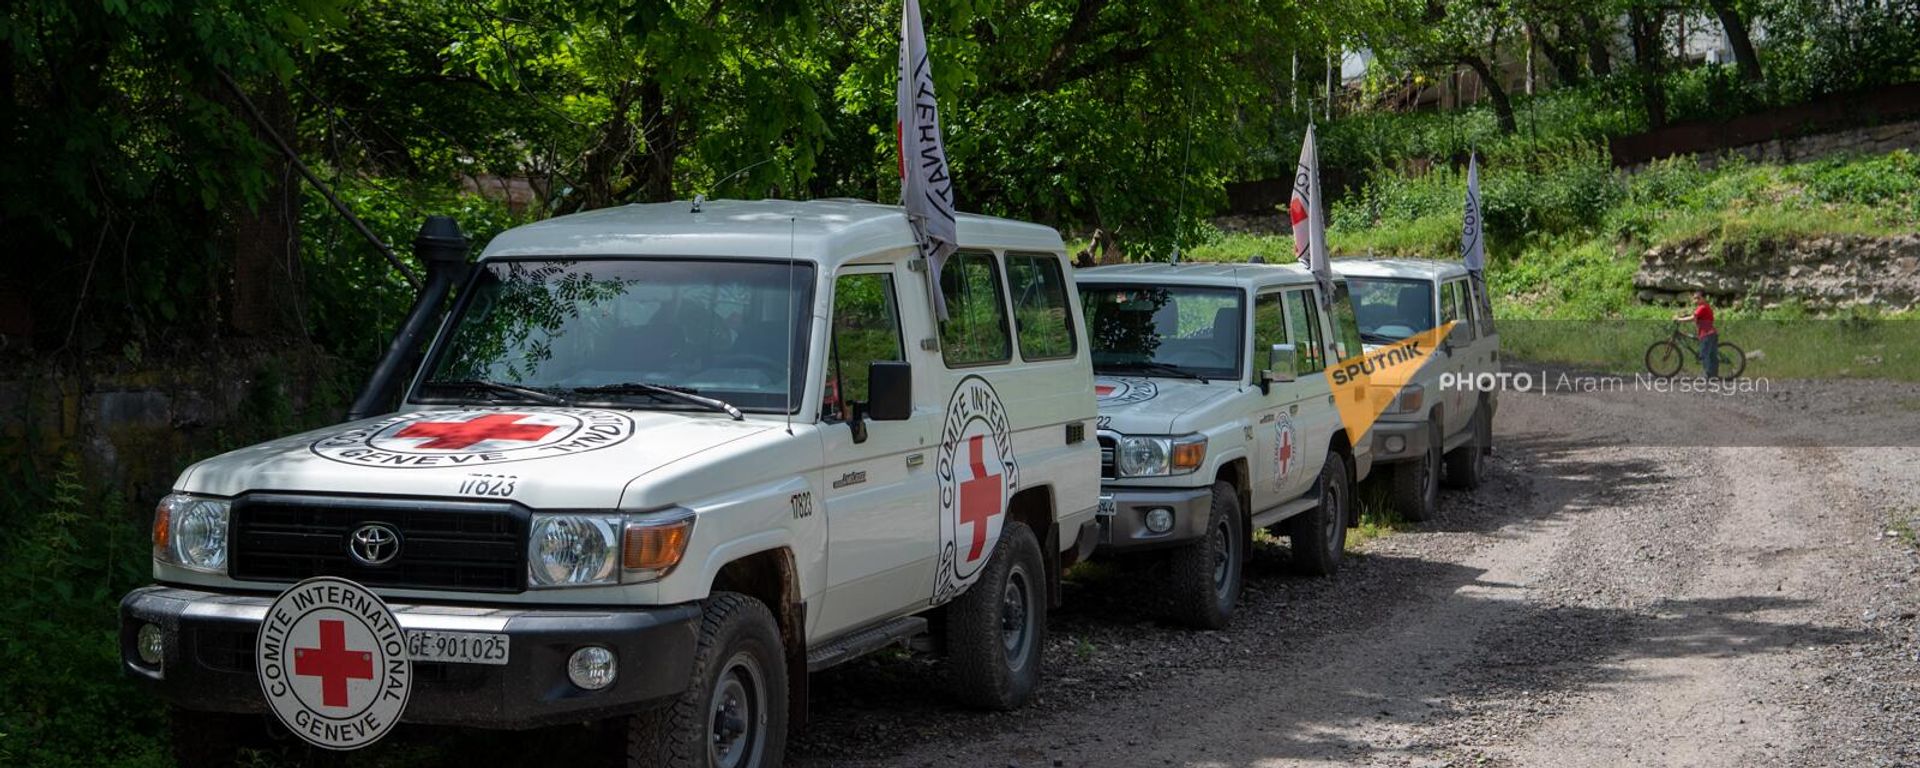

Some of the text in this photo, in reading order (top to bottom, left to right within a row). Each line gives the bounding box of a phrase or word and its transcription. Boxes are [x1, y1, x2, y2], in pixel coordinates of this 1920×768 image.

[339, 449, 508, 466] GENEVE
[940, 392, 970, 509] COMITE
[458, 473, 518, 496] 17823
[790, 491, 812, 519] 17823
[264, 586, 405, 701] COMITE INTERNATIONAL
[295, 709, 381, 742] GENEVE
